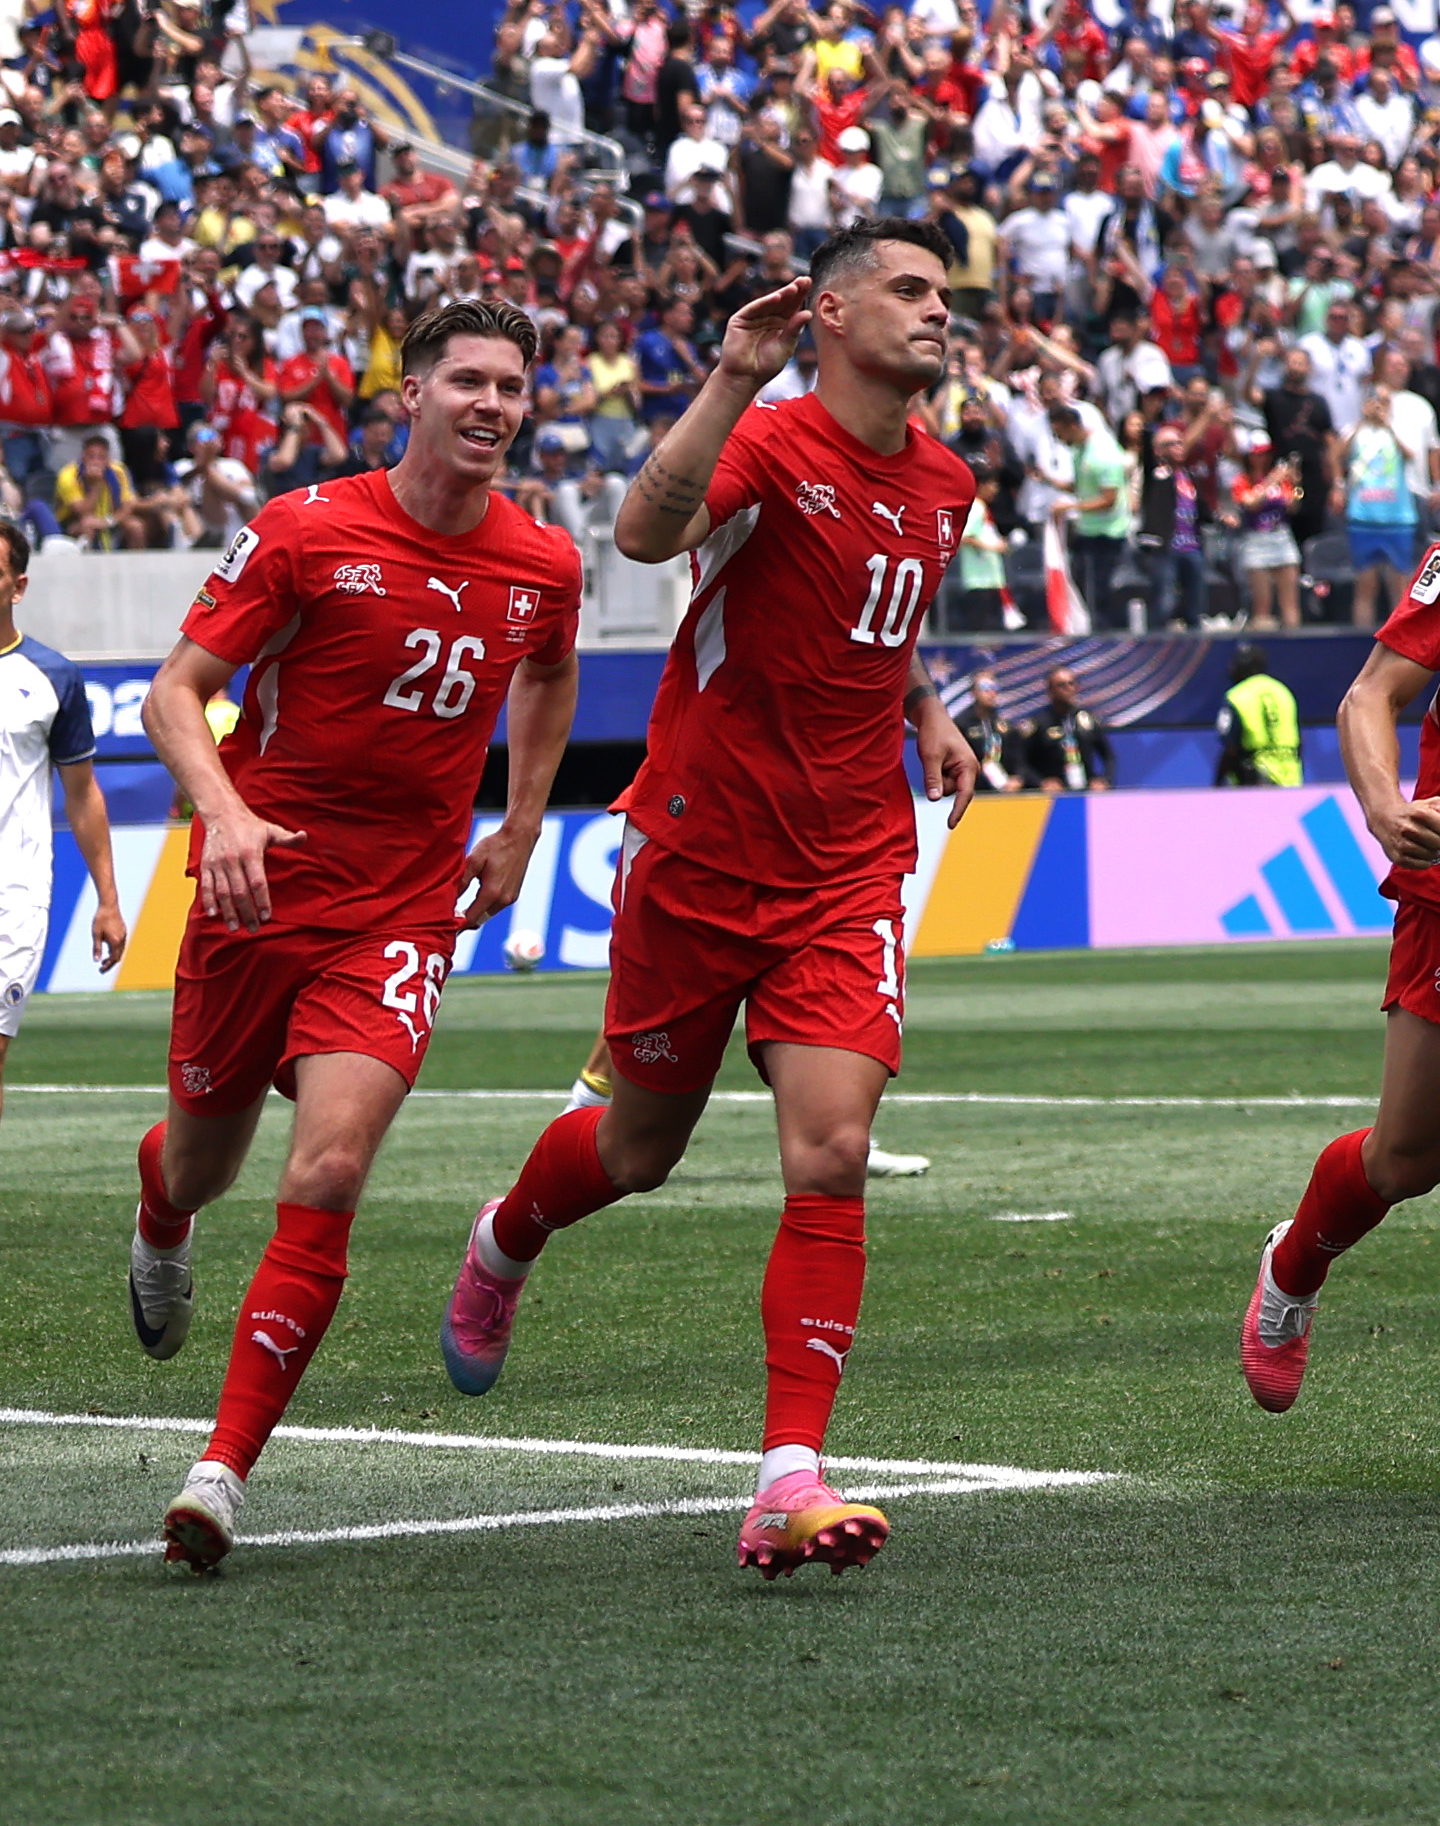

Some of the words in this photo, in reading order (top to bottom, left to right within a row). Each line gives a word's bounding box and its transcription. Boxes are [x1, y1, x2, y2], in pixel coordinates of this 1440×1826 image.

[850, 552, 924, 649] 10
[382, 627, 486, 719] 26
[379, 940, 446, 1030] 26
[873, 919, 905, 1000] 1
